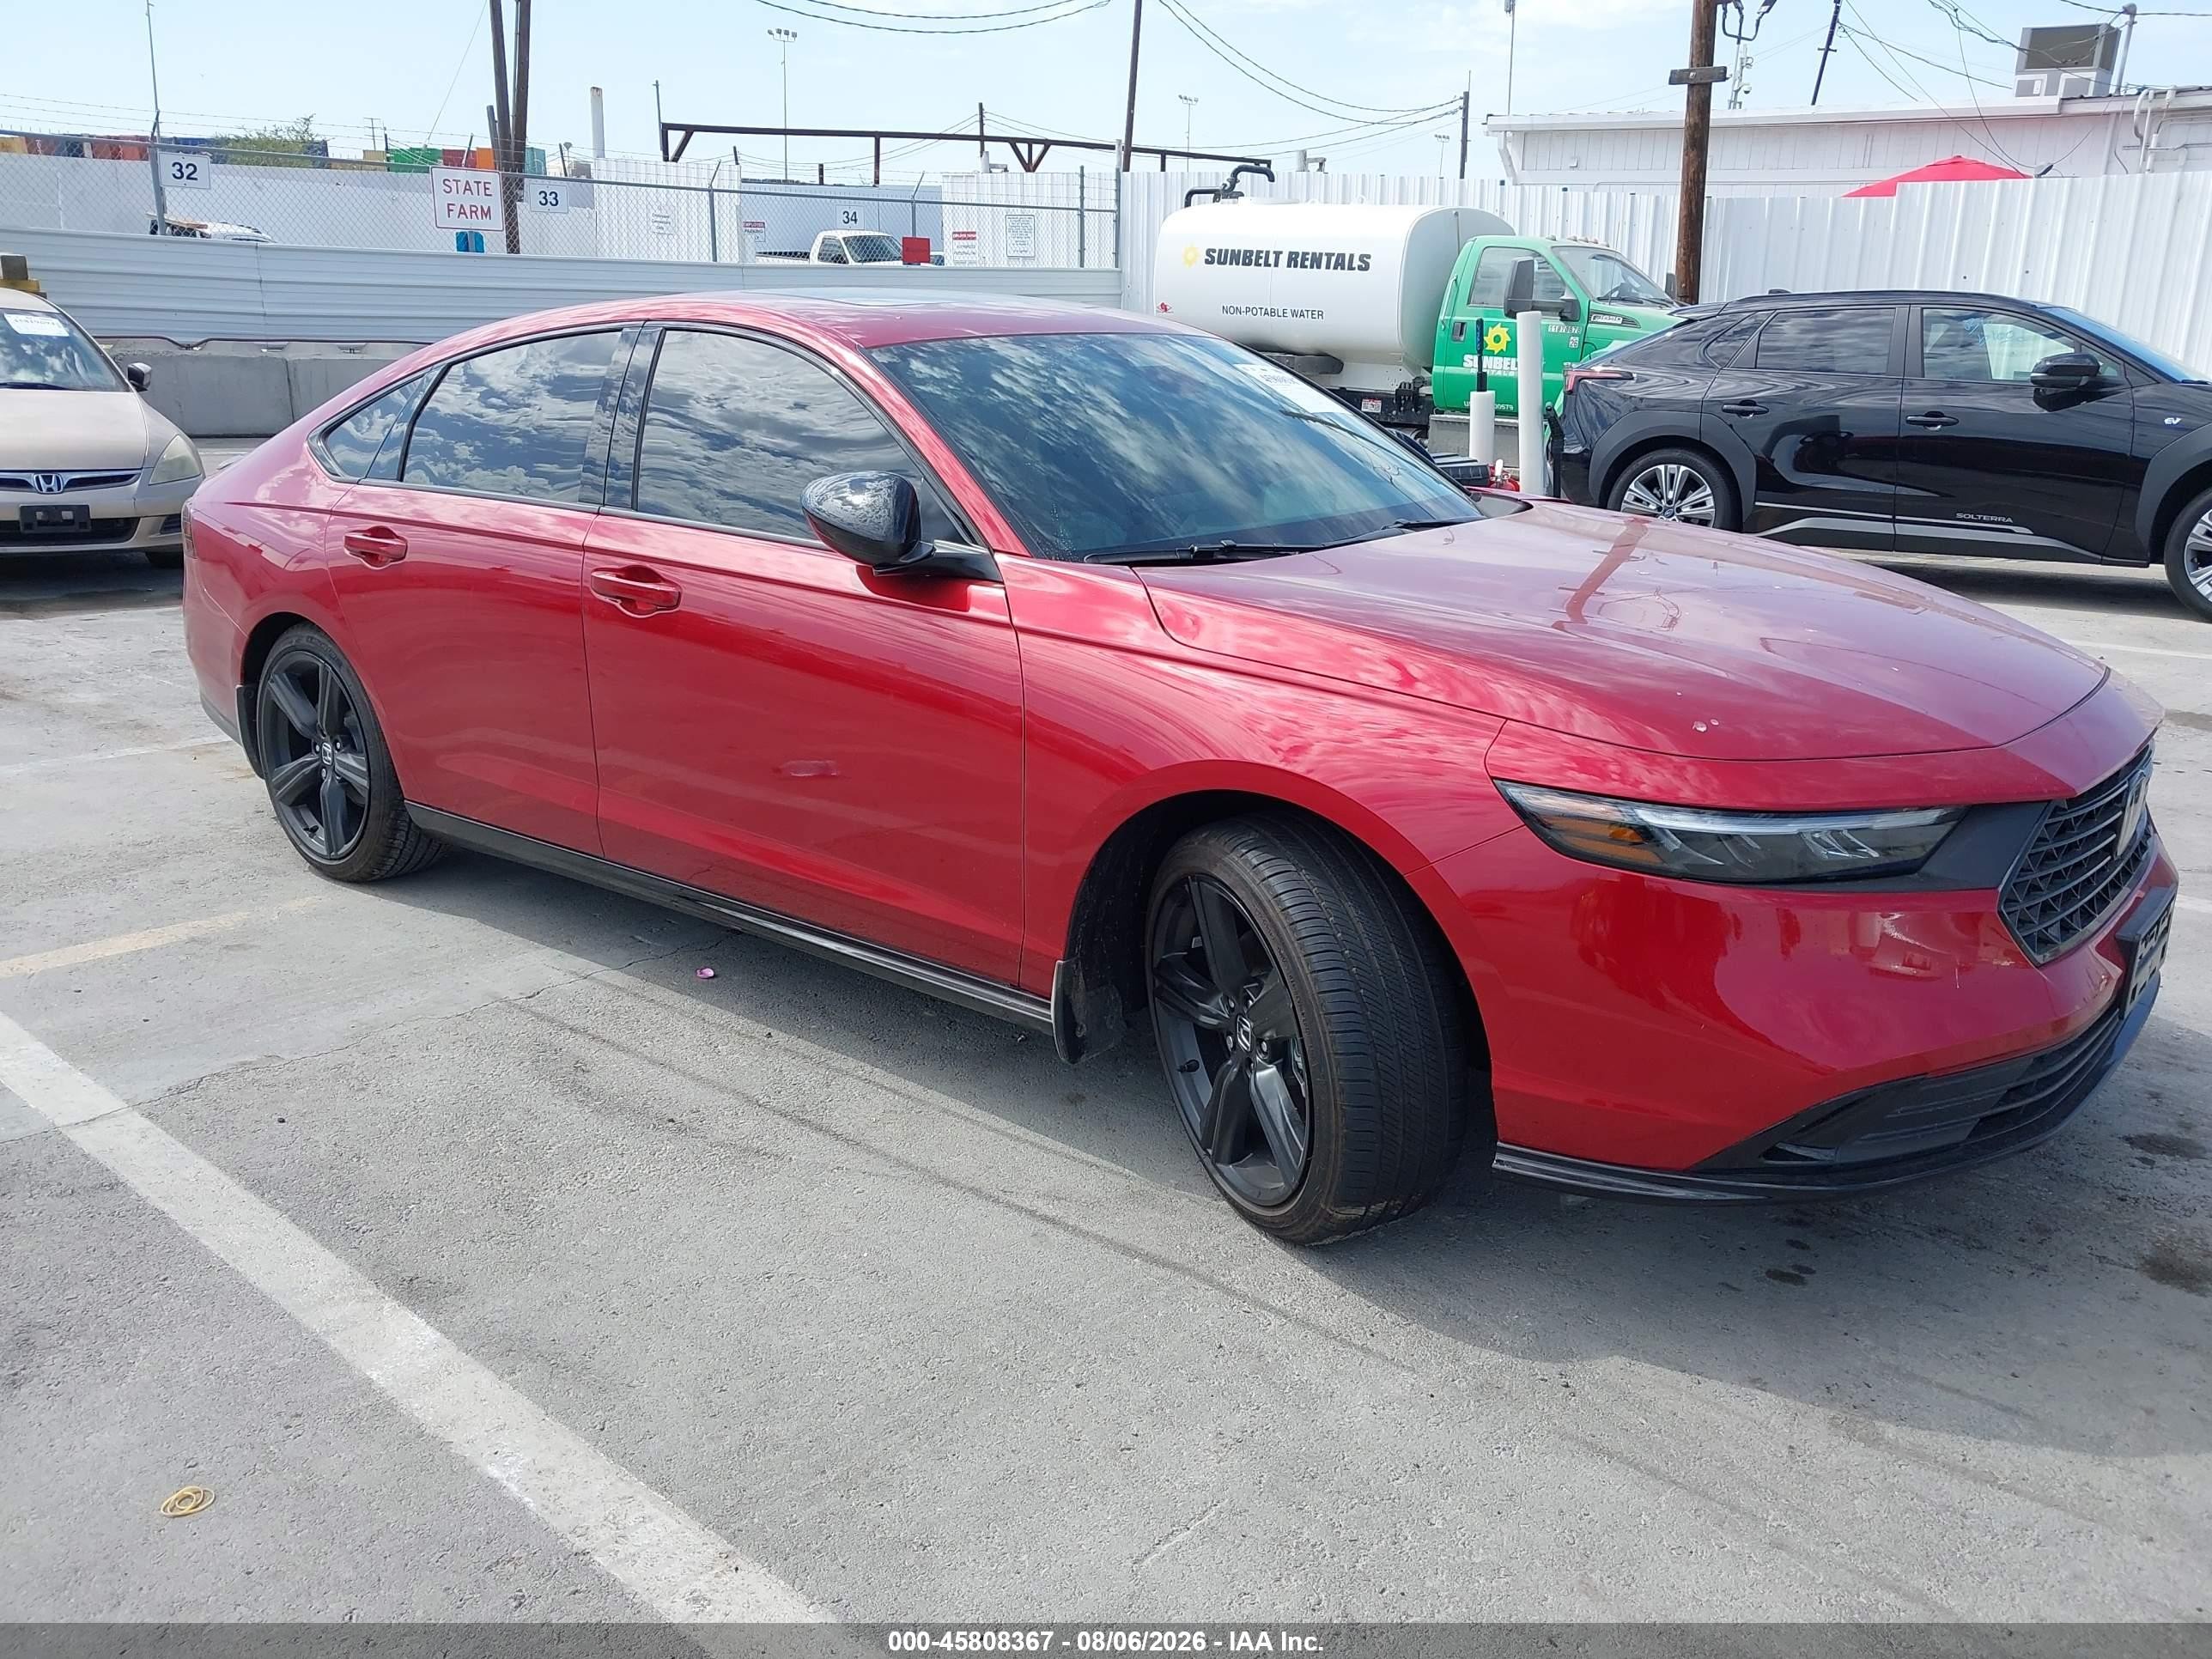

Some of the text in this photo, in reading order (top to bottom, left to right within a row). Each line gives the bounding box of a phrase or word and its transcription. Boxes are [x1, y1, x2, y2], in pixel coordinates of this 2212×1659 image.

[171, 161, 198, 181] 32
[442, 179, 493, 197] STATE
[538, 191, 559, 207] 33
[447, 203, 492, 221] FARM
[842, 210, 858, 224] 34
[1204, 247, 1371, 271] SUNBELT RENTALS
[1222, 305, 1324, 320] NON-POTABLE WATER
[1956, 513, 2013, 523] SOLTERRA
